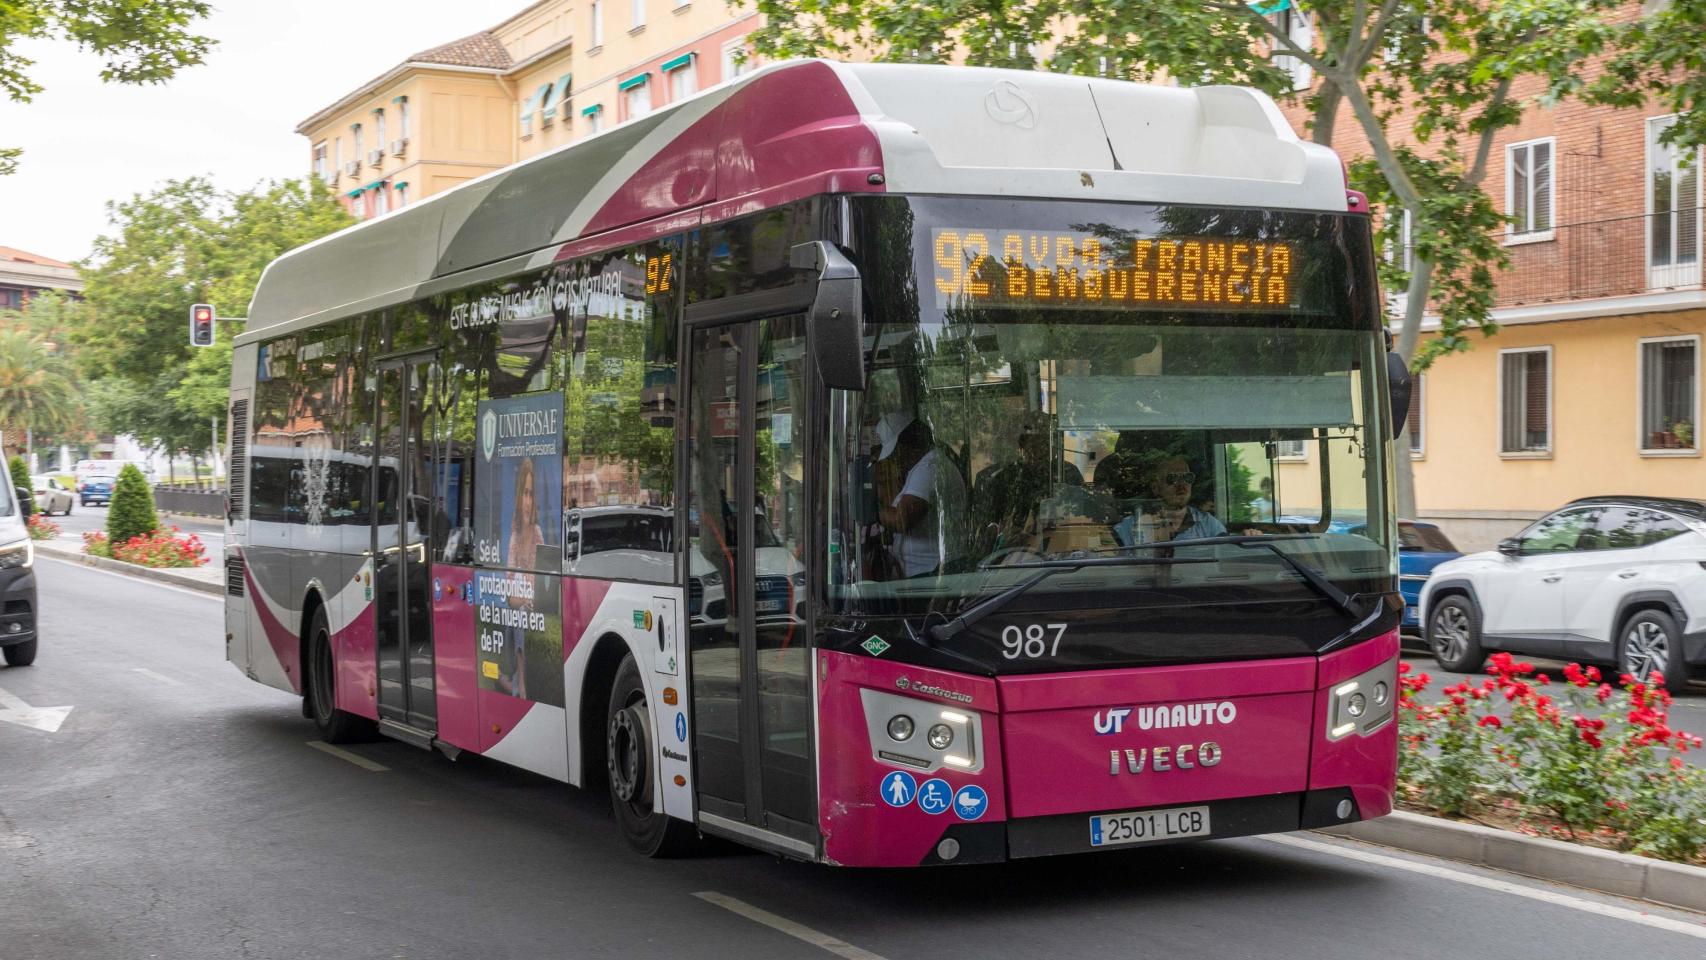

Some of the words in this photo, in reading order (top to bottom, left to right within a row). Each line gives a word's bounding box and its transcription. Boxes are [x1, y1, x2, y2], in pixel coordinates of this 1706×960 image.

[936, 232, 989, 294] 92
[1004, 234, 1114, 268] AVDA.
[1136, 240, 1289, 274] FRANCIA
[646, 254, 672, 294] 92
[1009, 266, 1285, 304] BENQUERENCIA
[450, 302, 469, 330] ESTE
[532, 284, 553, 315] CON
[554, 279, 580, 310] GAS
[580, 270, 624, 304] NATURAL
[499, 408, 558, 439] UNIVERSAE
[525, 439, 557, 456] Profesional
[479, 539, 491, 562] Sé
[491, 539, 500, 563] el
[479, 574, 534, 602] protagonista
[480, 601, 491, 623] de
[491, 604, 500, 625] la
[502, 611, 528, 630] nueva
[529, 614, 545, 632] era
[481, 628, 491, 652] de
[492, 631, 504, 655] FP
[866, 641, 885, 650] GNC
[1001, 623, 1068, 660] 987
[1138, 701, 1237, 731] UNAUTO
[1110, 741, 1222, 776] IVECO
[1108, 815, 1155, 841] 2501
[1165, 811, 1203, 835] LCB
